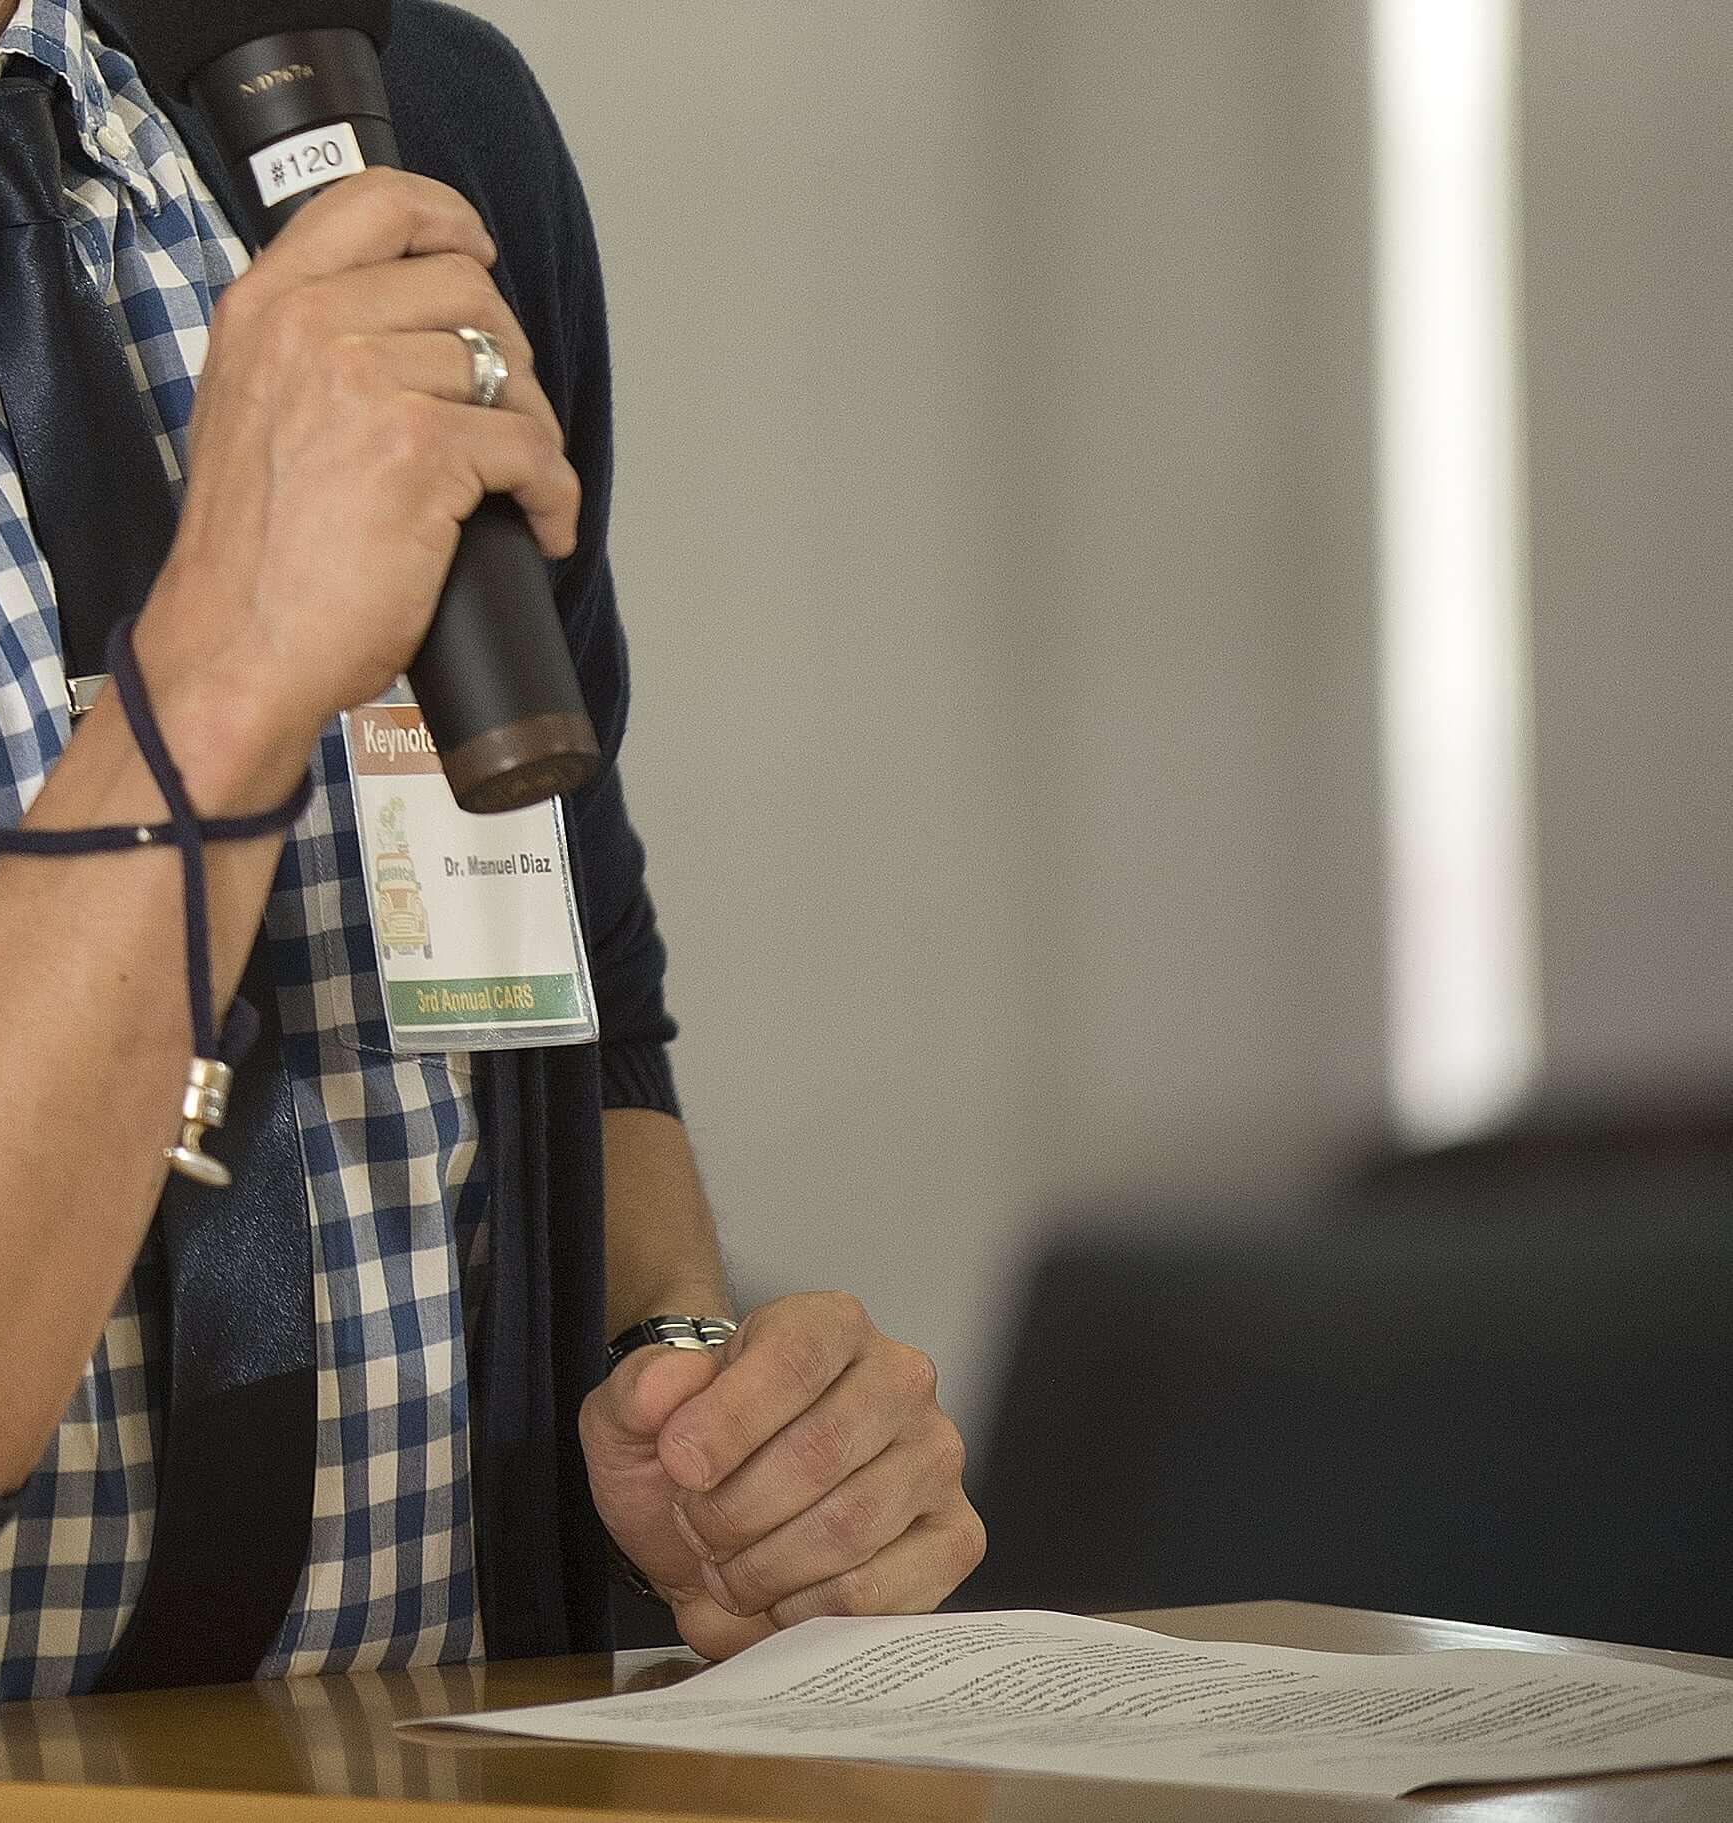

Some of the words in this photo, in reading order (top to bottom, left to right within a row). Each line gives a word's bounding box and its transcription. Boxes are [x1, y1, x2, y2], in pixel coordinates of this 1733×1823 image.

[270, 140, 344, 187] #120
[362, 720, 437, 762] Keynote
[444, 856, 466, 876] Dr.
[467, 854, 517, 875] Manuel
[520, 853, 551, 874] Diaz
[417, 988, 440, 1013] 3rd
[441, 987, 493, 1012] Annual
[493, 984, 535, 1009] CARS
